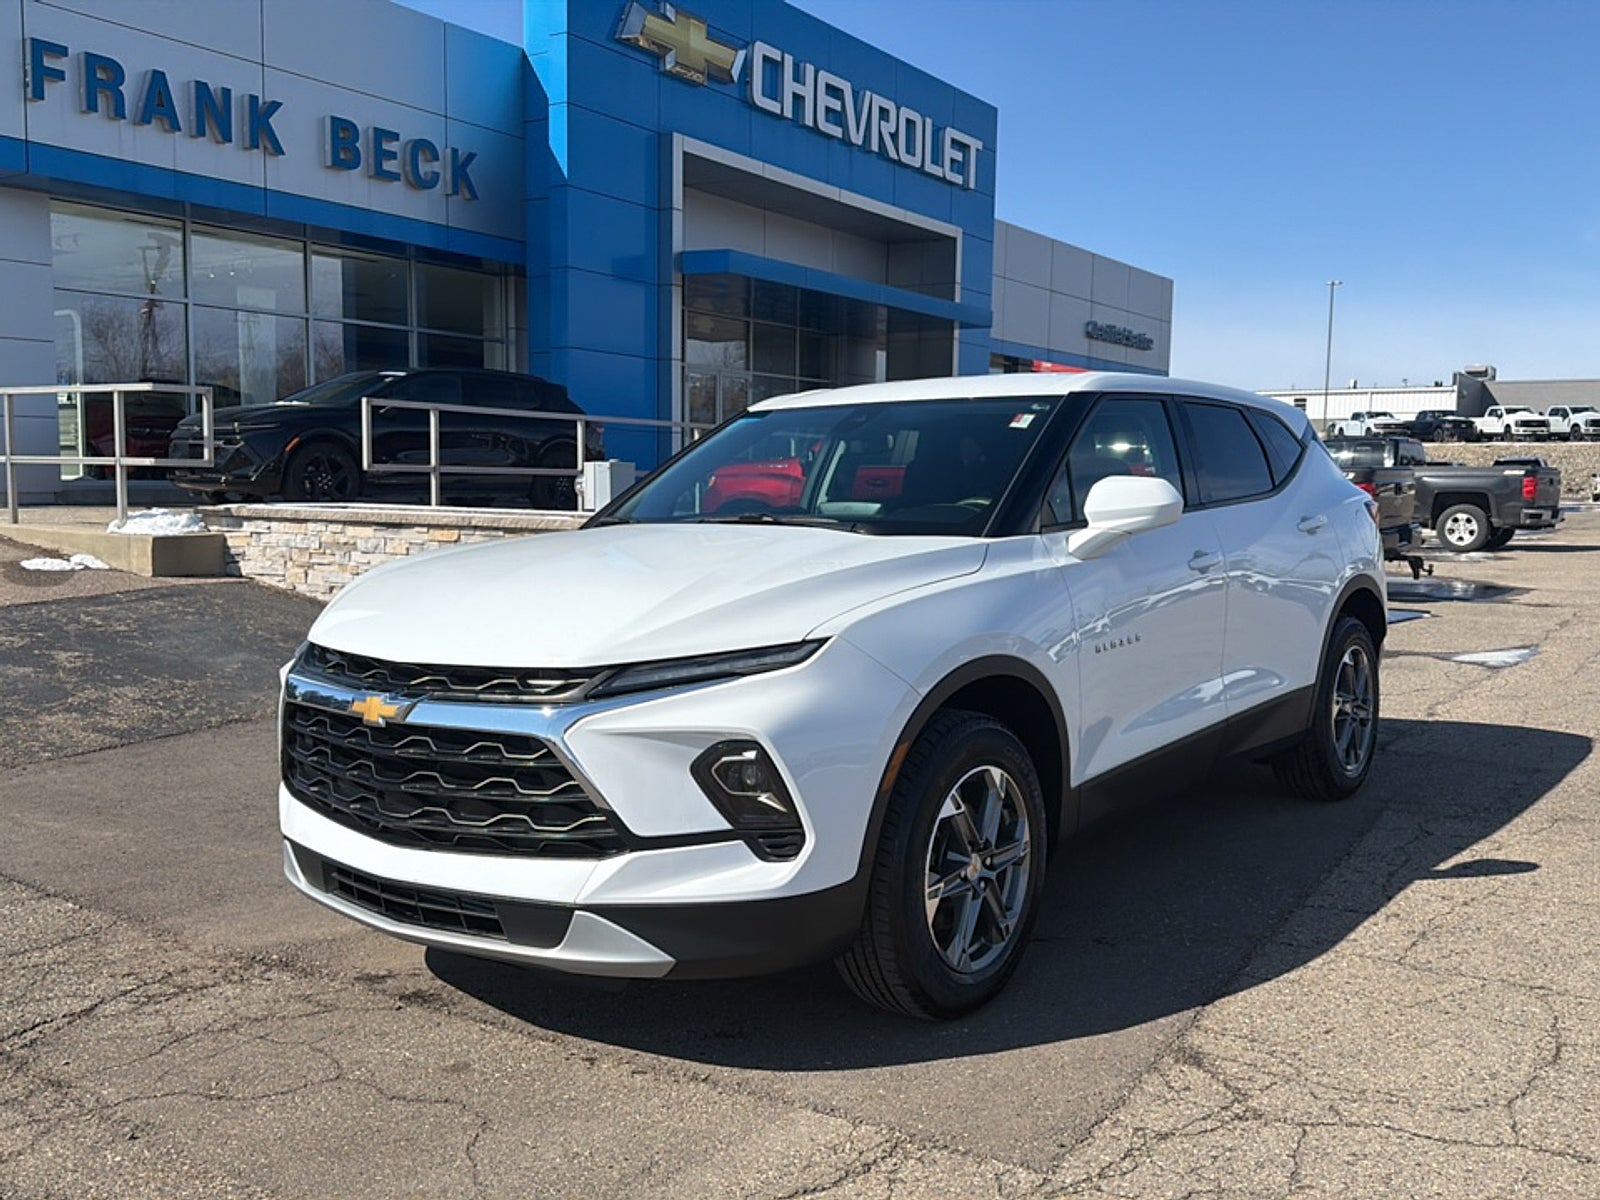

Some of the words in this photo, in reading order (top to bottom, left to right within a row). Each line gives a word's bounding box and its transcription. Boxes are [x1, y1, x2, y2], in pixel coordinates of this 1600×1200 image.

[27, 37, 285, 156] FRANK
[324, 115, 479, 201] BECK
[750, 41, 983, 190] CHEVROLET
